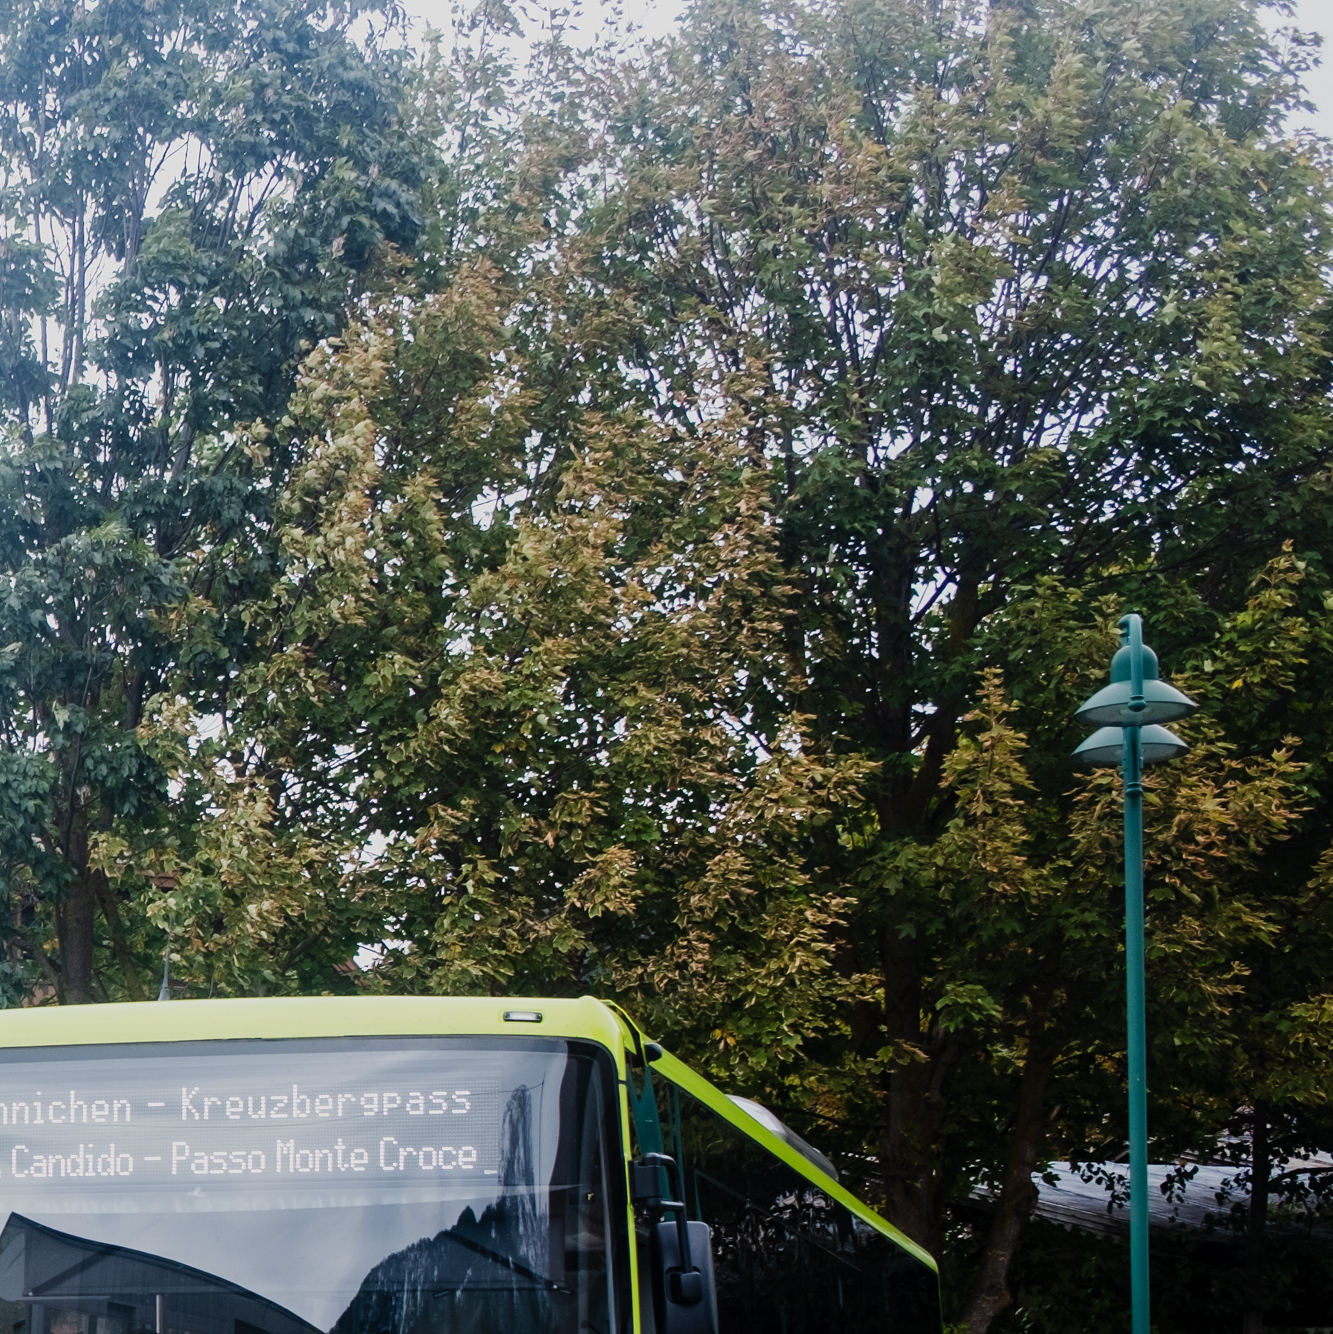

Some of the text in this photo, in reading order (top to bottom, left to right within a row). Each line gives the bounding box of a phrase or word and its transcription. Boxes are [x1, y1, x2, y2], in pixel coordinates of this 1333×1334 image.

[180, 1083, 472, 1121] Kreuzbergpass
[11, 1143, 134, 1178] Candido
[171, 1141, 266, 1175] Passo
[276, 1137, 369, 1173] Monte
[379, 1136, 477, 1171] Croce
